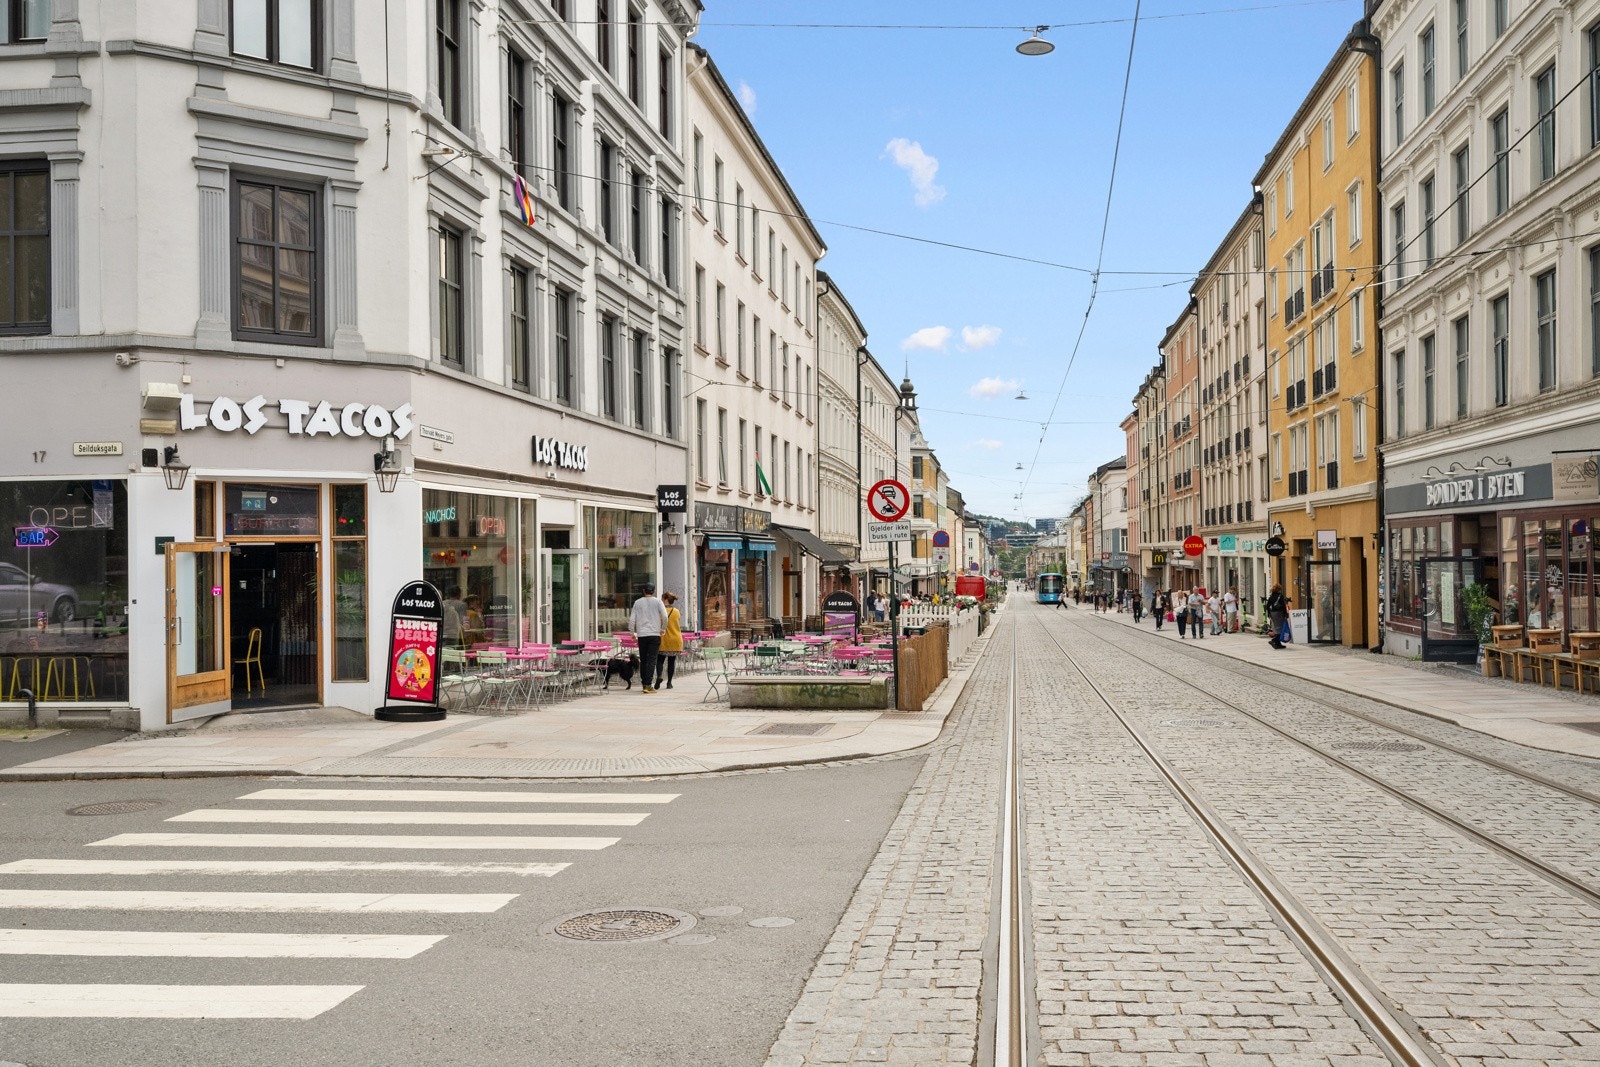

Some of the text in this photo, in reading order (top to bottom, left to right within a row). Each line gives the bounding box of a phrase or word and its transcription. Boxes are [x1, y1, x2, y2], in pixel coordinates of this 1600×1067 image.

[179, 393, 415, 441] LOS TACOS
[78, 444, 118, 454] Seilduksgata
[533, 435, 589, 473] LOS TACOS
[32, 450, 47, 463] 17
[664, 491, 680, 499] LOS
[1426, 471, 1526, 506] BØNDER I BYEN
[660, 499, 684, 507] TACOS
[424, 505, 456, 524] NACHOS
[479, 516, 506, 536] OPEN
[870, 525, 893, 533] Gjelder
[19, 531, 45, 544] BAR
[401, 599, 435, 609] LOS TACOS
[395, 618, 438, 632] LUNCH
[394, 629, 438, 643] DEALS
